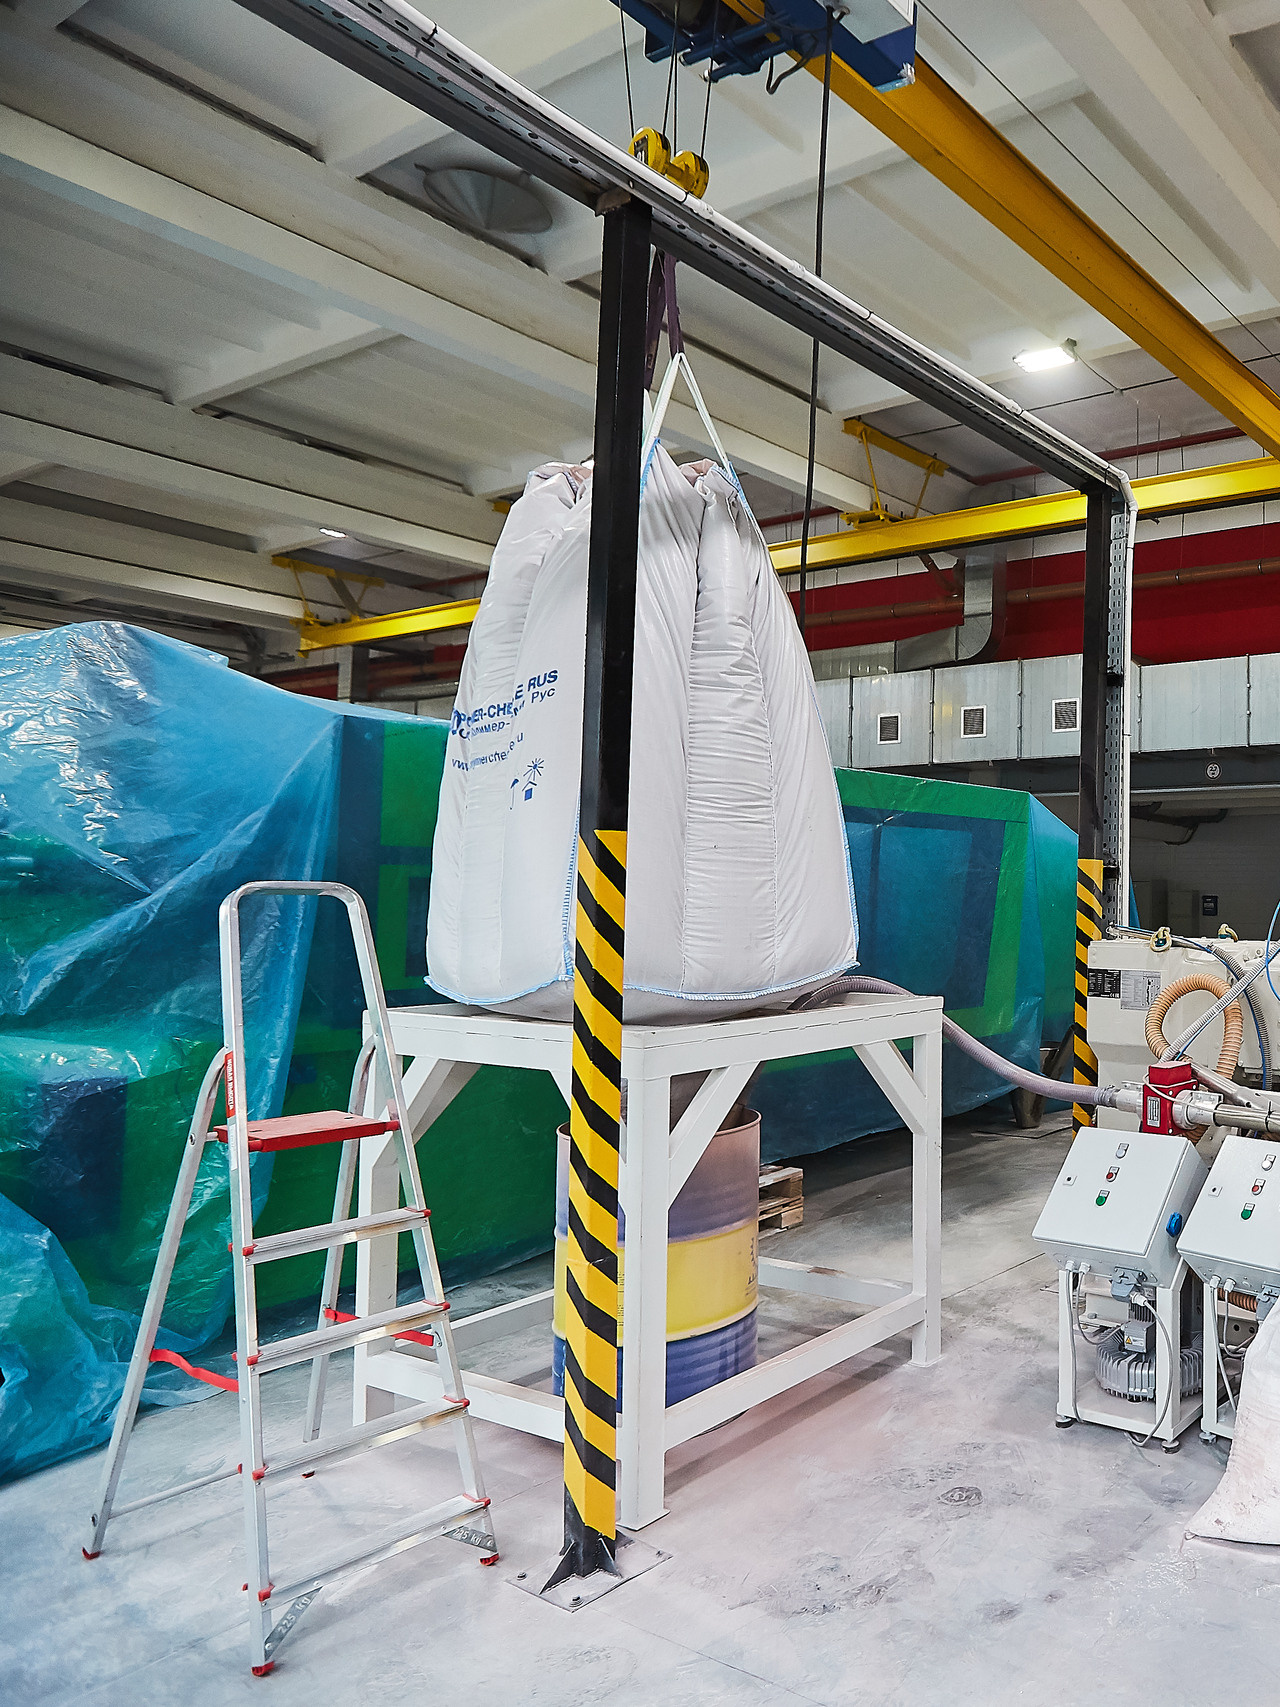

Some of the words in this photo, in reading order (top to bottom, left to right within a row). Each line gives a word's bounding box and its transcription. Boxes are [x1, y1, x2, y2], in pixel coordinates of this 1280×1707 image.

[527, 670, 558, 692] RUS
[531, 688, 556, 703] Рус
[277, 1613, 296, 1634] 225
[295, 1596, 312, 1611] kg
